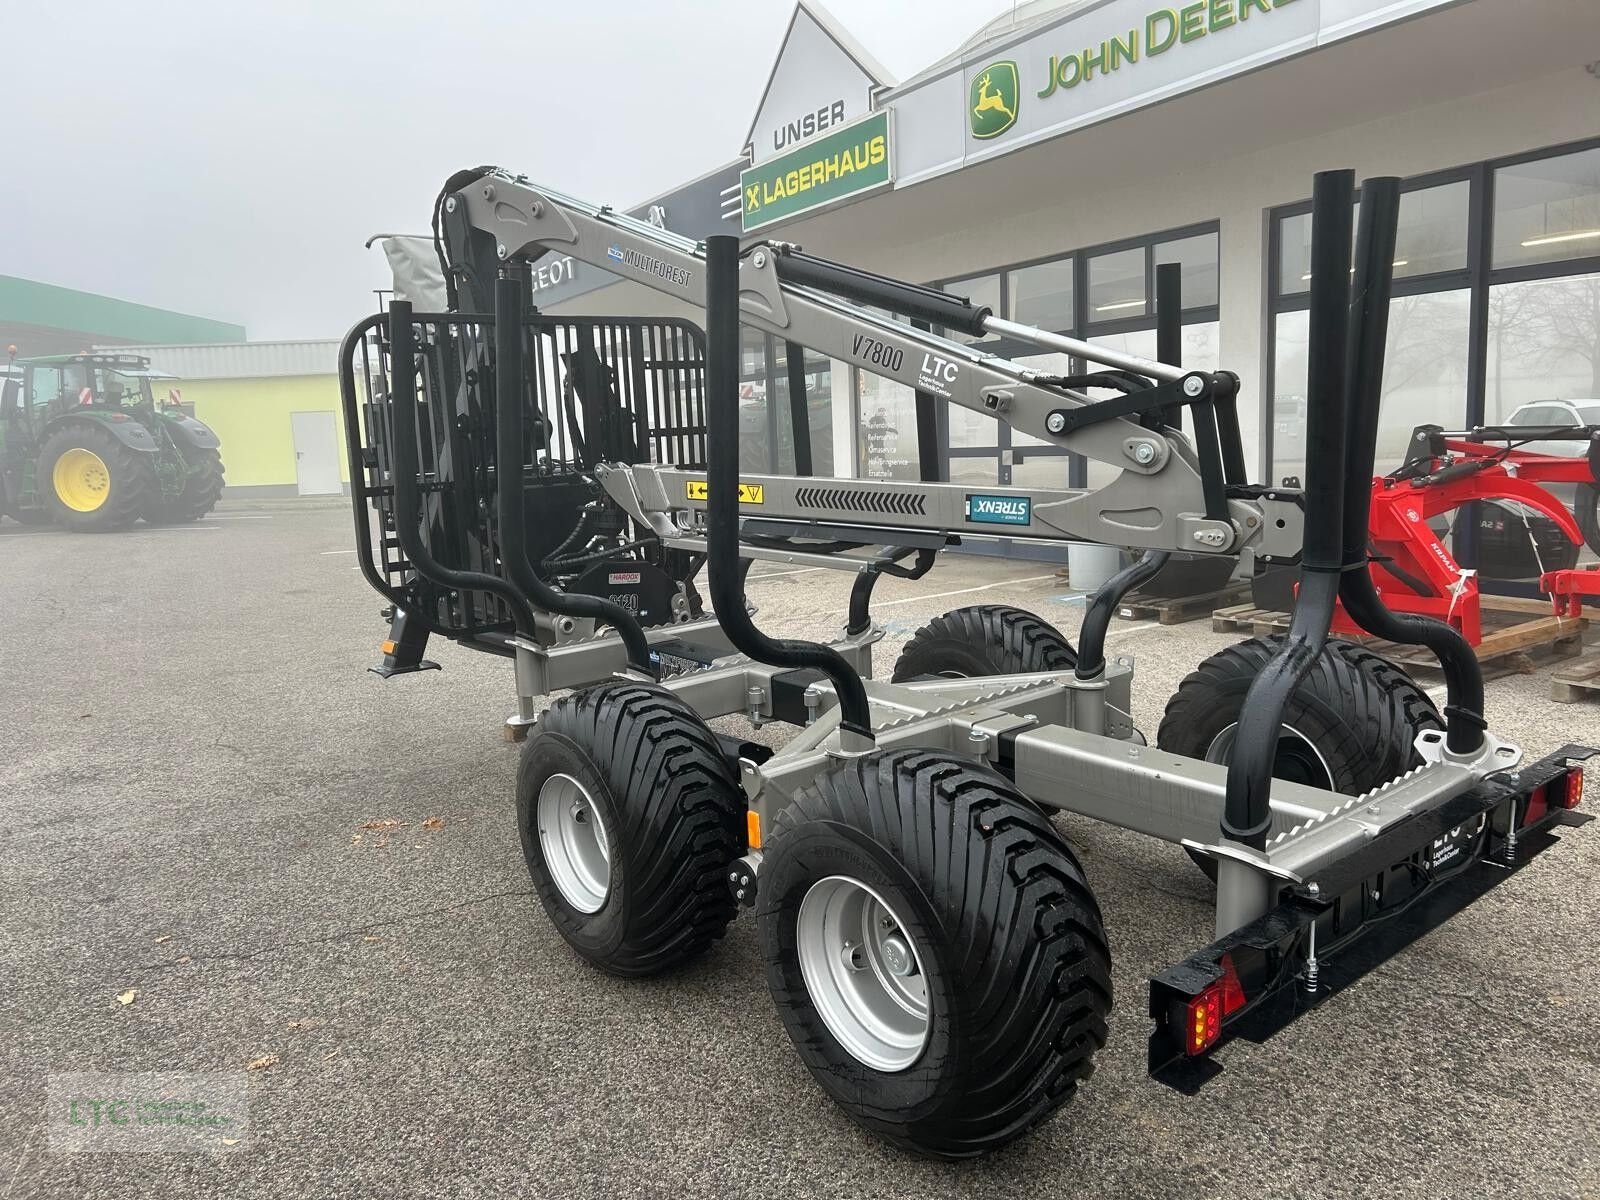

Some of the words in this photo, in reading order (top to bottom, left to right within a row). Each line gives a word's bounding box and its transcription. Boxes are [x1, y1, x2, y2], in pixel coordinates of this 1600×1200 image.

[1037, 28, 1138, 98] JOHN
[773, 99, 845, 151] UNSER
[763, 135, 886, 205] LAGERHAUS
[624, 249, 692, 288] MULTIFOREST
[921, 353, 959, 382] LTC
